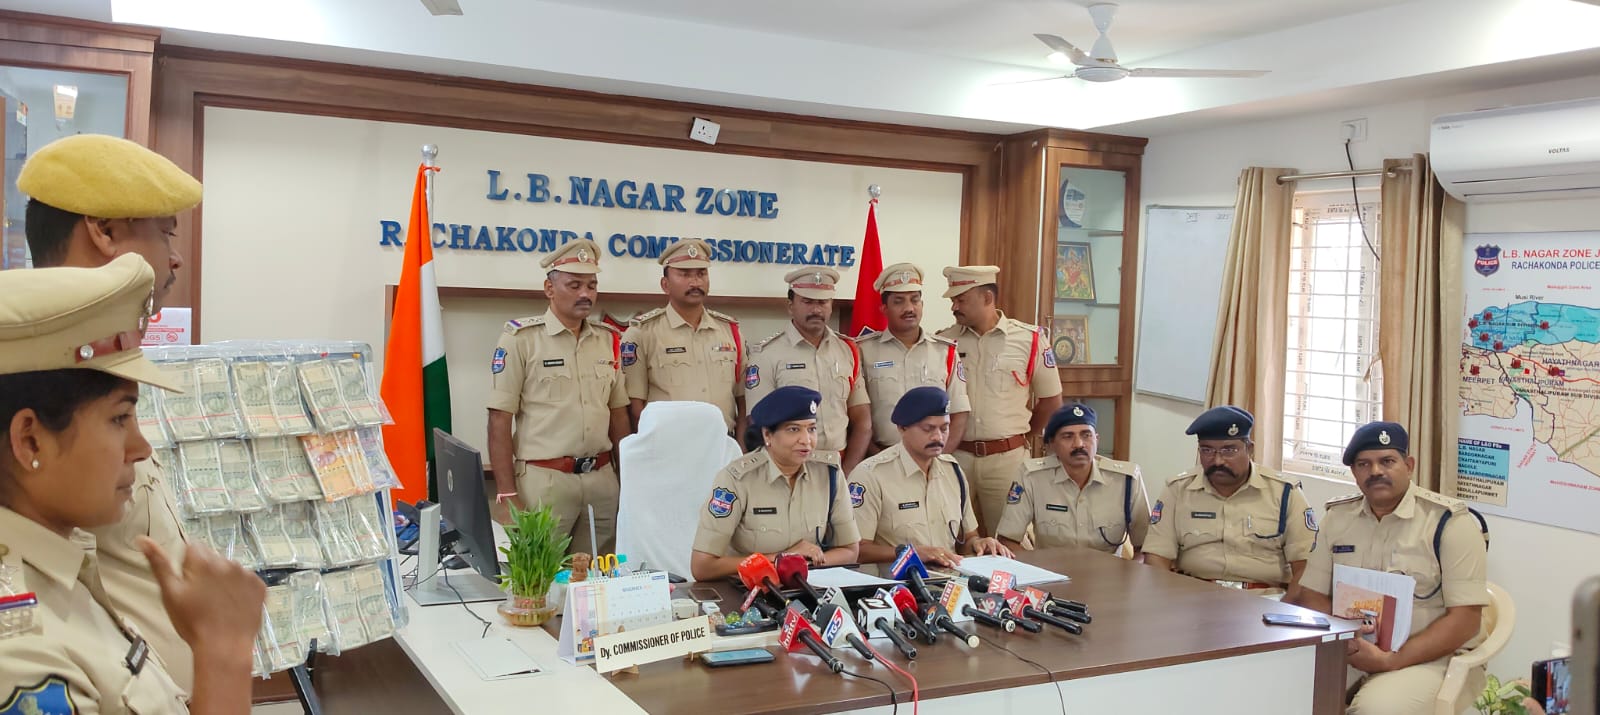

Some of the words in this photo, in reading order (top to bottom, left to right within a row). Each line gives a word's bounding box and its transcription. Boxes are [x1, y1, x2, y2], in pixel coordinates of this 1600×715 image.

[695, 187, 779, 219] ZONE
[1523, 250, 1559, 258] NAGAR
[1561, 249, 1592, 258] ZONE
[1511, 261, 1568, 270] RACHAKONDA
[1570, 261, 1600, 270] POLICE
[1542, 358, 1600, 368] HAYATHNAGAR
[1462, 376, 1496, 385] MEERPET
[782, 614, 798, 649] hmtv
[600, 647, 612, 660] Dy.
[613, 634, 670, 656] COMMISSIONER
[670, 632, 680, 644] OF
[681, 626, 706, 642] POLICE
